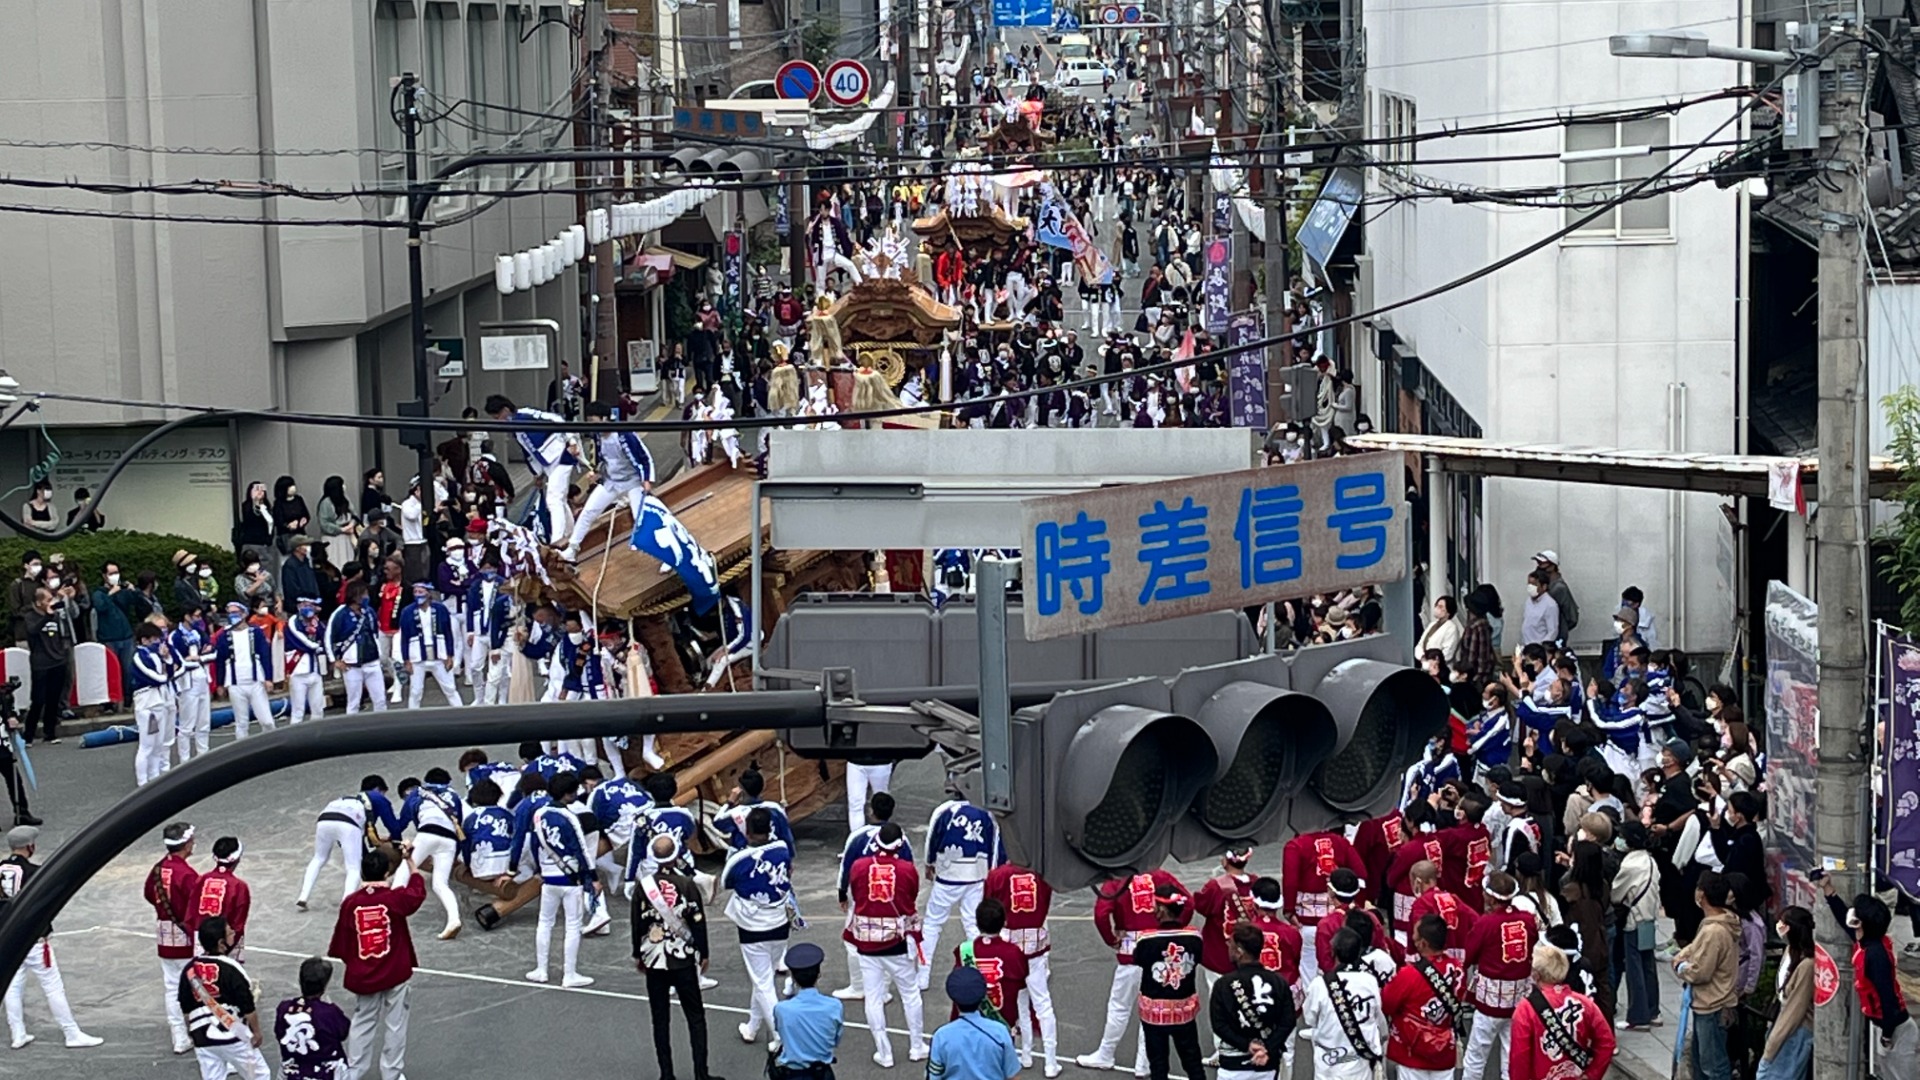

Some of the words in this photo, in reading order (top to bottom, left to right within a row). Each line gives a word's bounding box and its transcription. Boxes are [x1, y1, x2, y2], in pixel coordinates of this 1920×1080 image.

[835, 73, 859, 92] 40
[1035, 471, 1394, 617] 時差信号
[281, 1011, 320, 1055] 原
